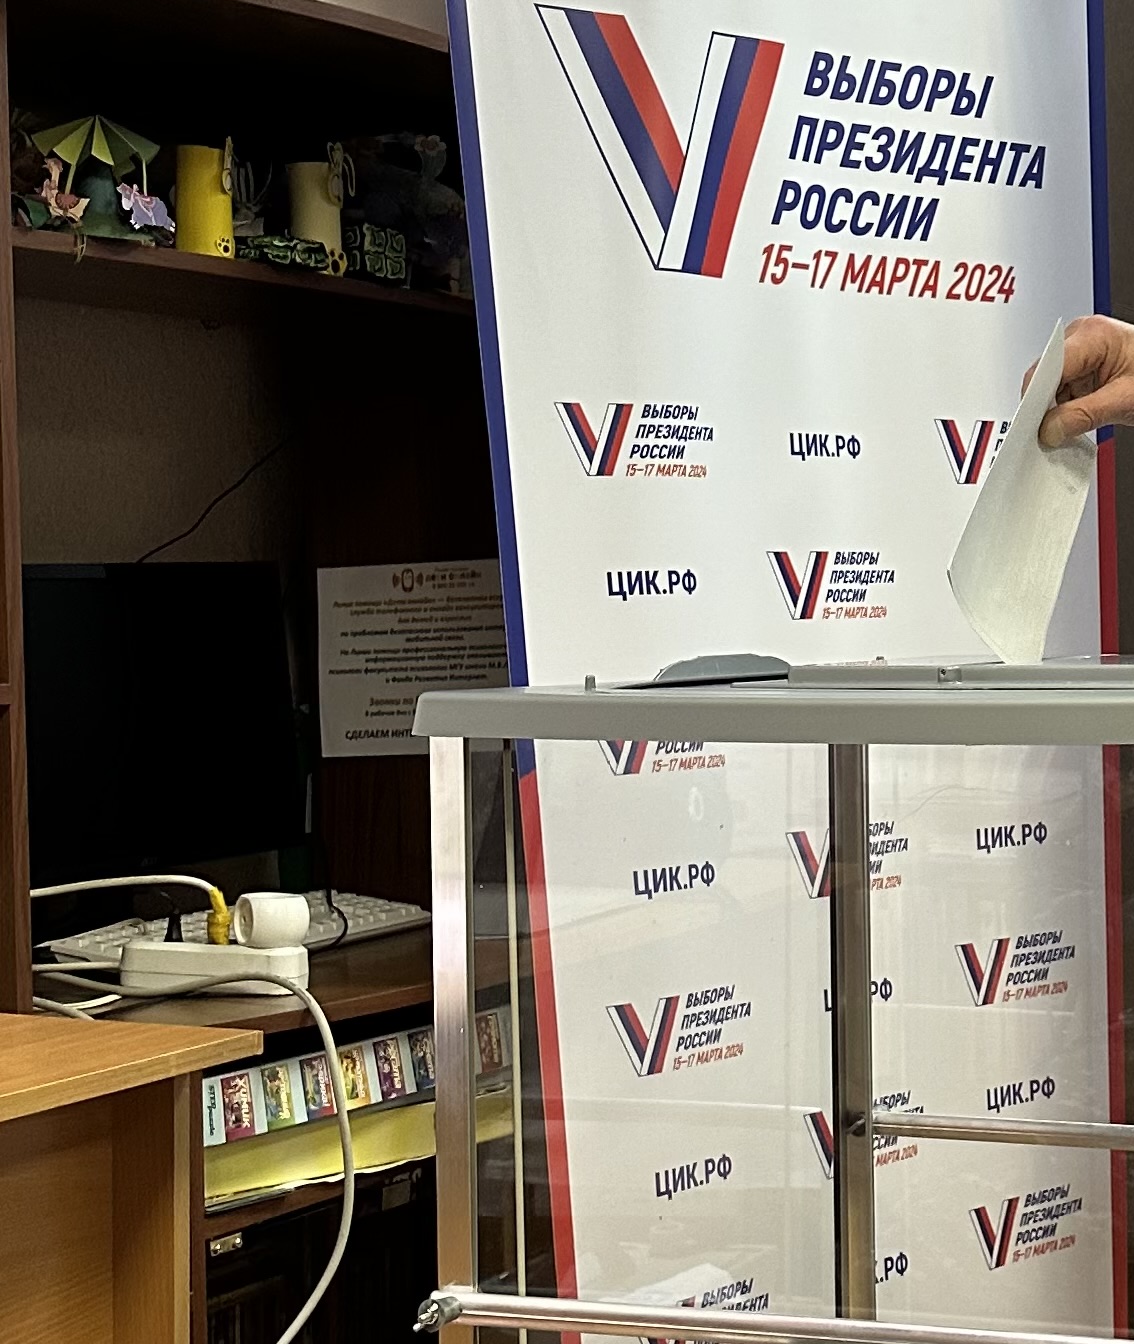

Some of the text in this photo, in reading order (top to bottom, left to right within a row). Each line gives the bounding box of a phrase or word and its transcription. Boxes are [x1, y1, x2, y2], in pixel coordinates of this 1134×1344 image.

[803, 51, 994, 120] ВЫБОРЫ
[788, 116, 1047, 189] ПРЕЗИДЕНТА
[771, 181, 939, 242] РОССИИ
[840, 254, 939, 299] МАРТА
[946, 263, 1016, 304] 2024
[641, 404, 699, 420] ВЫБОРЫ
[635, 424, 714, 442] ПРЕЗИДЕНТА
[629, 444, 685, 459] РОССИИ
[789, 432, 861, 461] ЦИК.РФ
[655, 464, 686, 477] МАРТА
[688, 465, 707, 477] 2024
[834, 551, 880, 565] ВЫБОРЫ
[606, 569, 697, 601] ЦИК.РФ
[829, 570, 895, 585] ПРЕЗИДЕНТА
[825, 589, 867, 603] РОССИИ
[868, 821, 895, 837] БОРЫ
[976, 821, 1048, 853] ЦИК.РФ
[632, 860, 716, 900] ЦИК.РФ
[1015, 930, 1063, 950] ВЫБОРЫ
[1010, 945, 1076, 968] ПРЕЗИДЕНТА
[1006, 967, 1049, 987] РОССИИ
[685, 984, 735, 1009] ВЫБОРЫ
[680, 1002, 752, 1030] ПРЕЗИДЕНТА
[676, 1028, 722, 1052] РОССИИ
[986, 1076, 1056, 1113] ЦИК.РФ
[655, 1153, 732, 1200] ЦИК.РФ
[1024, 1184, 1071, 1208] ВЫБОРЫ
[1020, 1197, 1082, 1227] ПРЕЗИДЕНТА
[1015, 1223, 1058, 1246] РОССИИ
[701, 1278, 754, 1309] ВЫБОРЫ
